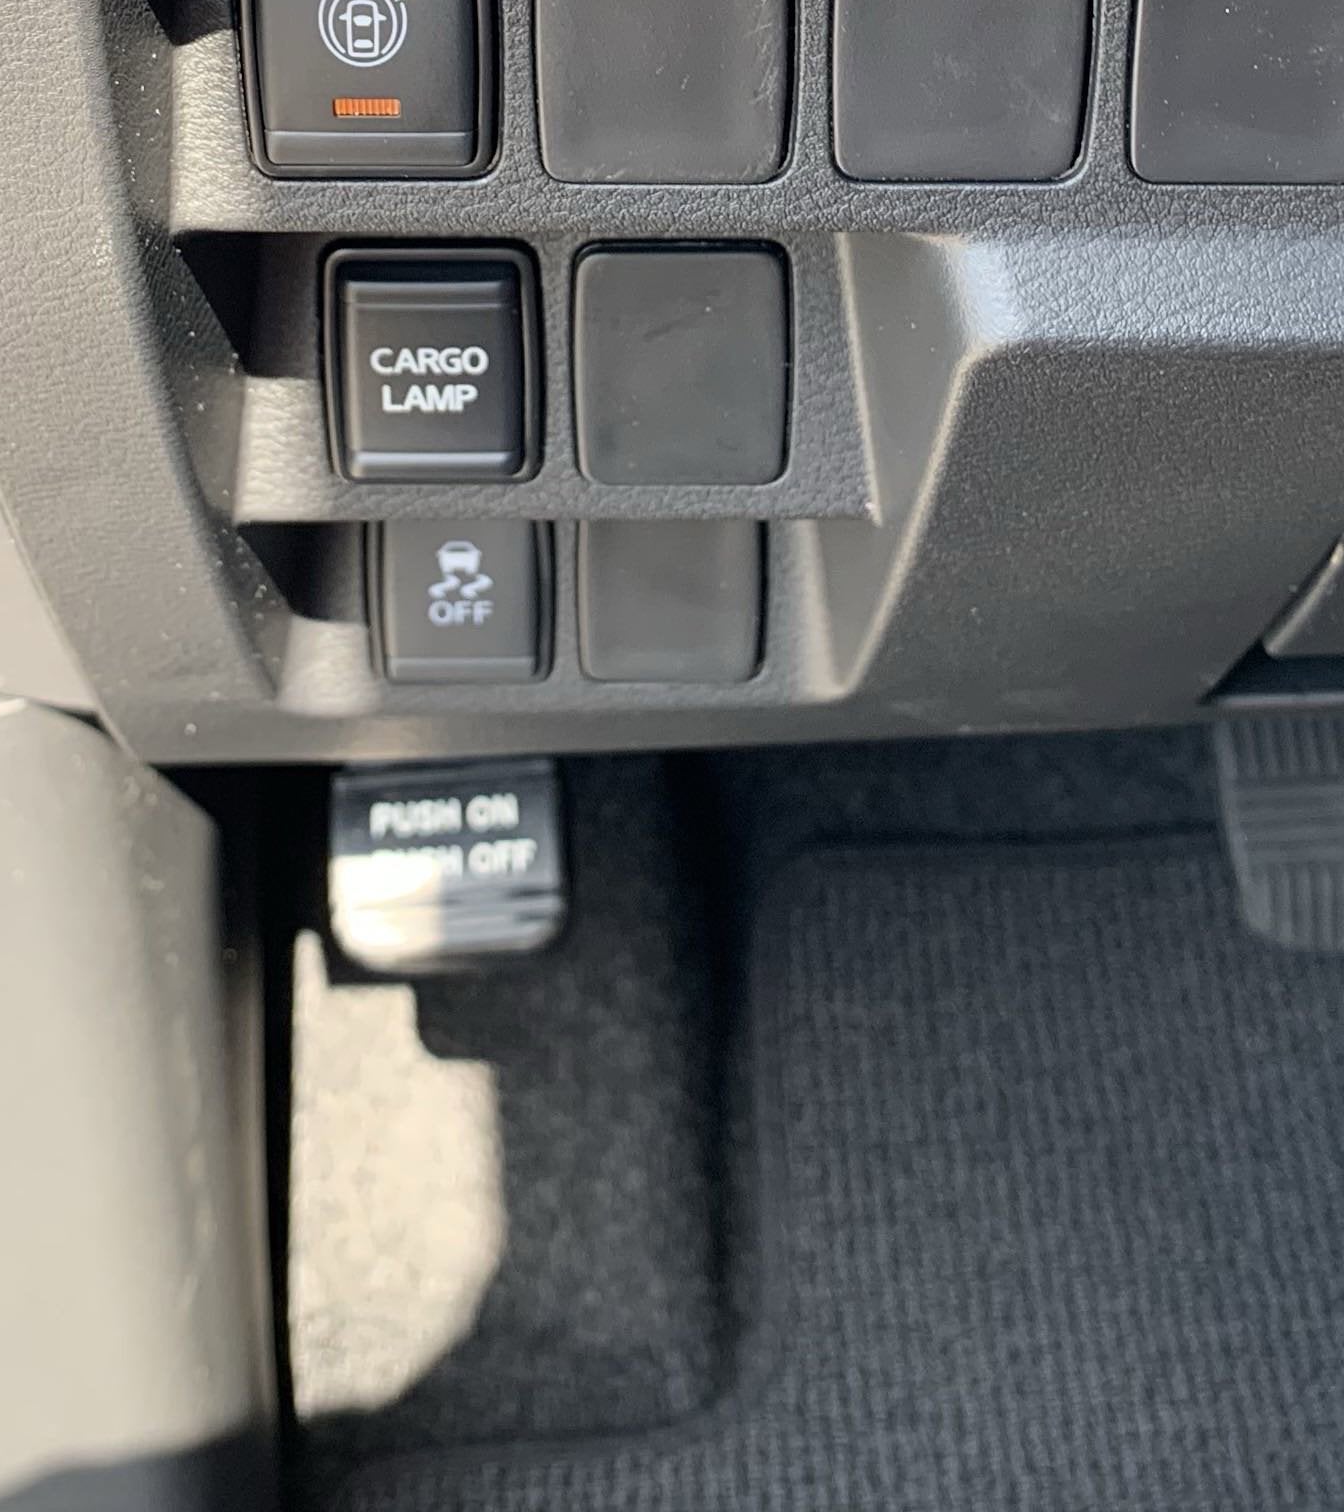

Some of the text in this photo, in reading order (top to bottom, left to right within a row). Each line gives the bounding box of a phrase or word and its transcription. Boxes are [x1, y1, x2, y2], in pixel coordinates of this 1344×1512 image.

[369, 346, 489, 375] CARGO
[381, 384, 478, 413] LAMP
[428, 600, 494, 626] OFF
[370, 793, 519, 838] PUSH ON
[468, 838, 538, 876] OFF
